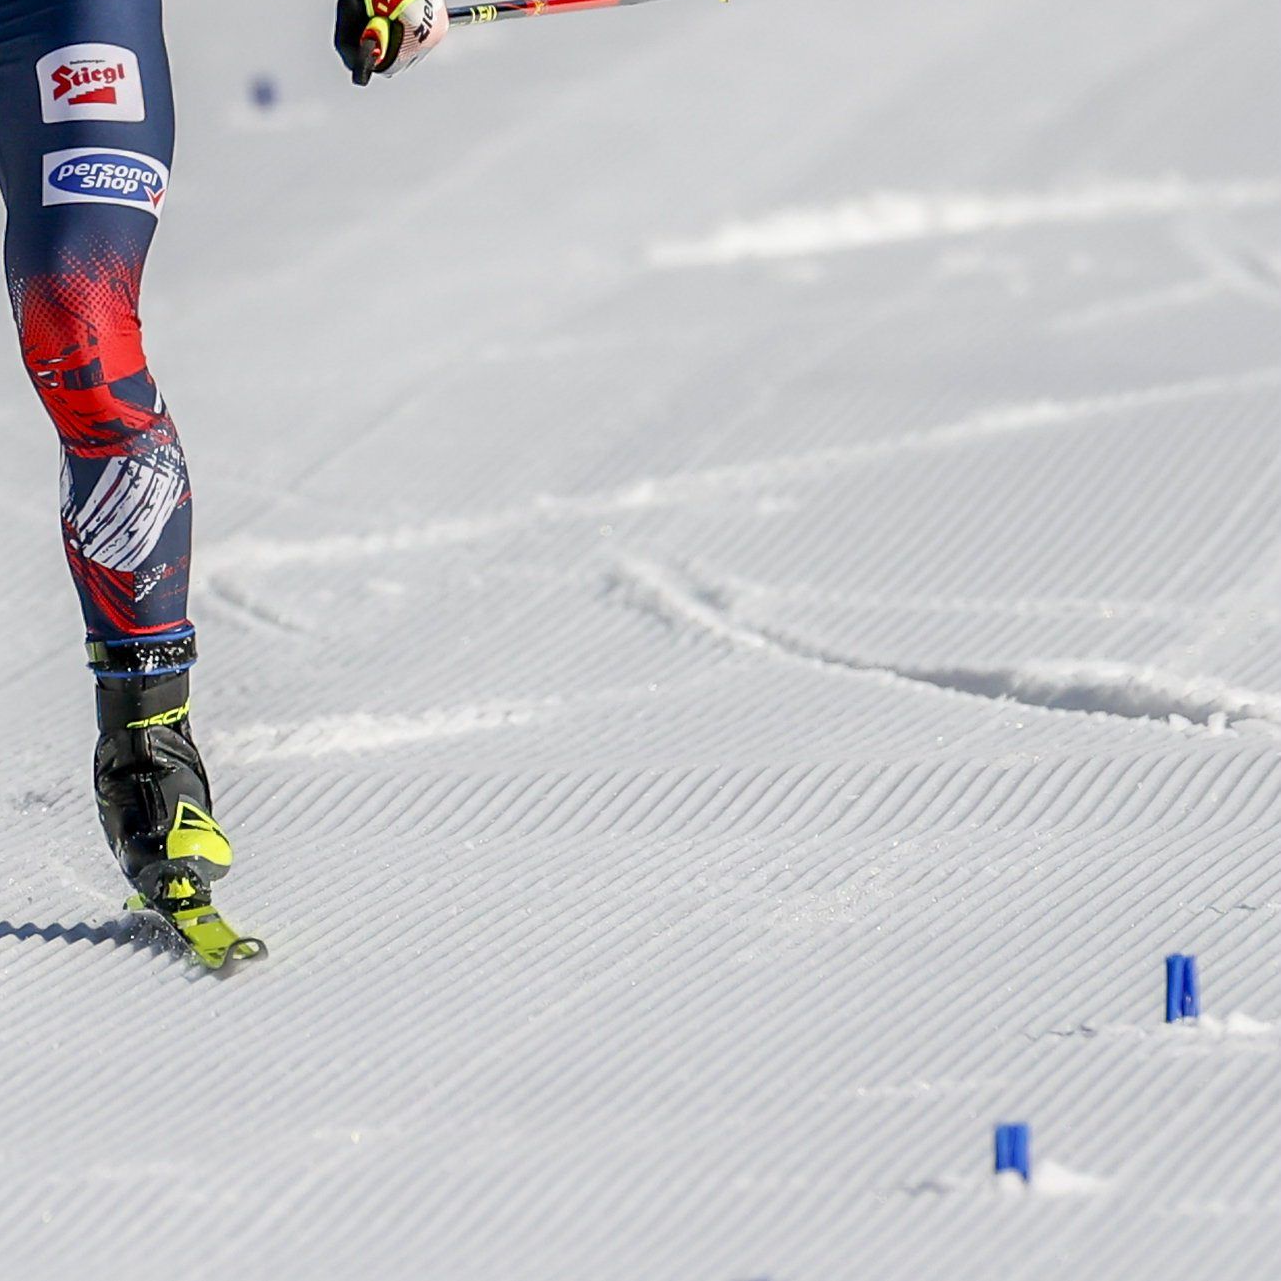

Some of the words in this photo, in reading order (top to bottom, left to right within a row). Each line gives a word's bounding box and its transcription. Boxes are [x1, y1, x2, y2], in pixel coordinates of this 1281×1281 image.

[51, 63, 126, 101] Stiegl
[57, 163, 159, 186] personal
[80, 172, 139, 195] shop
